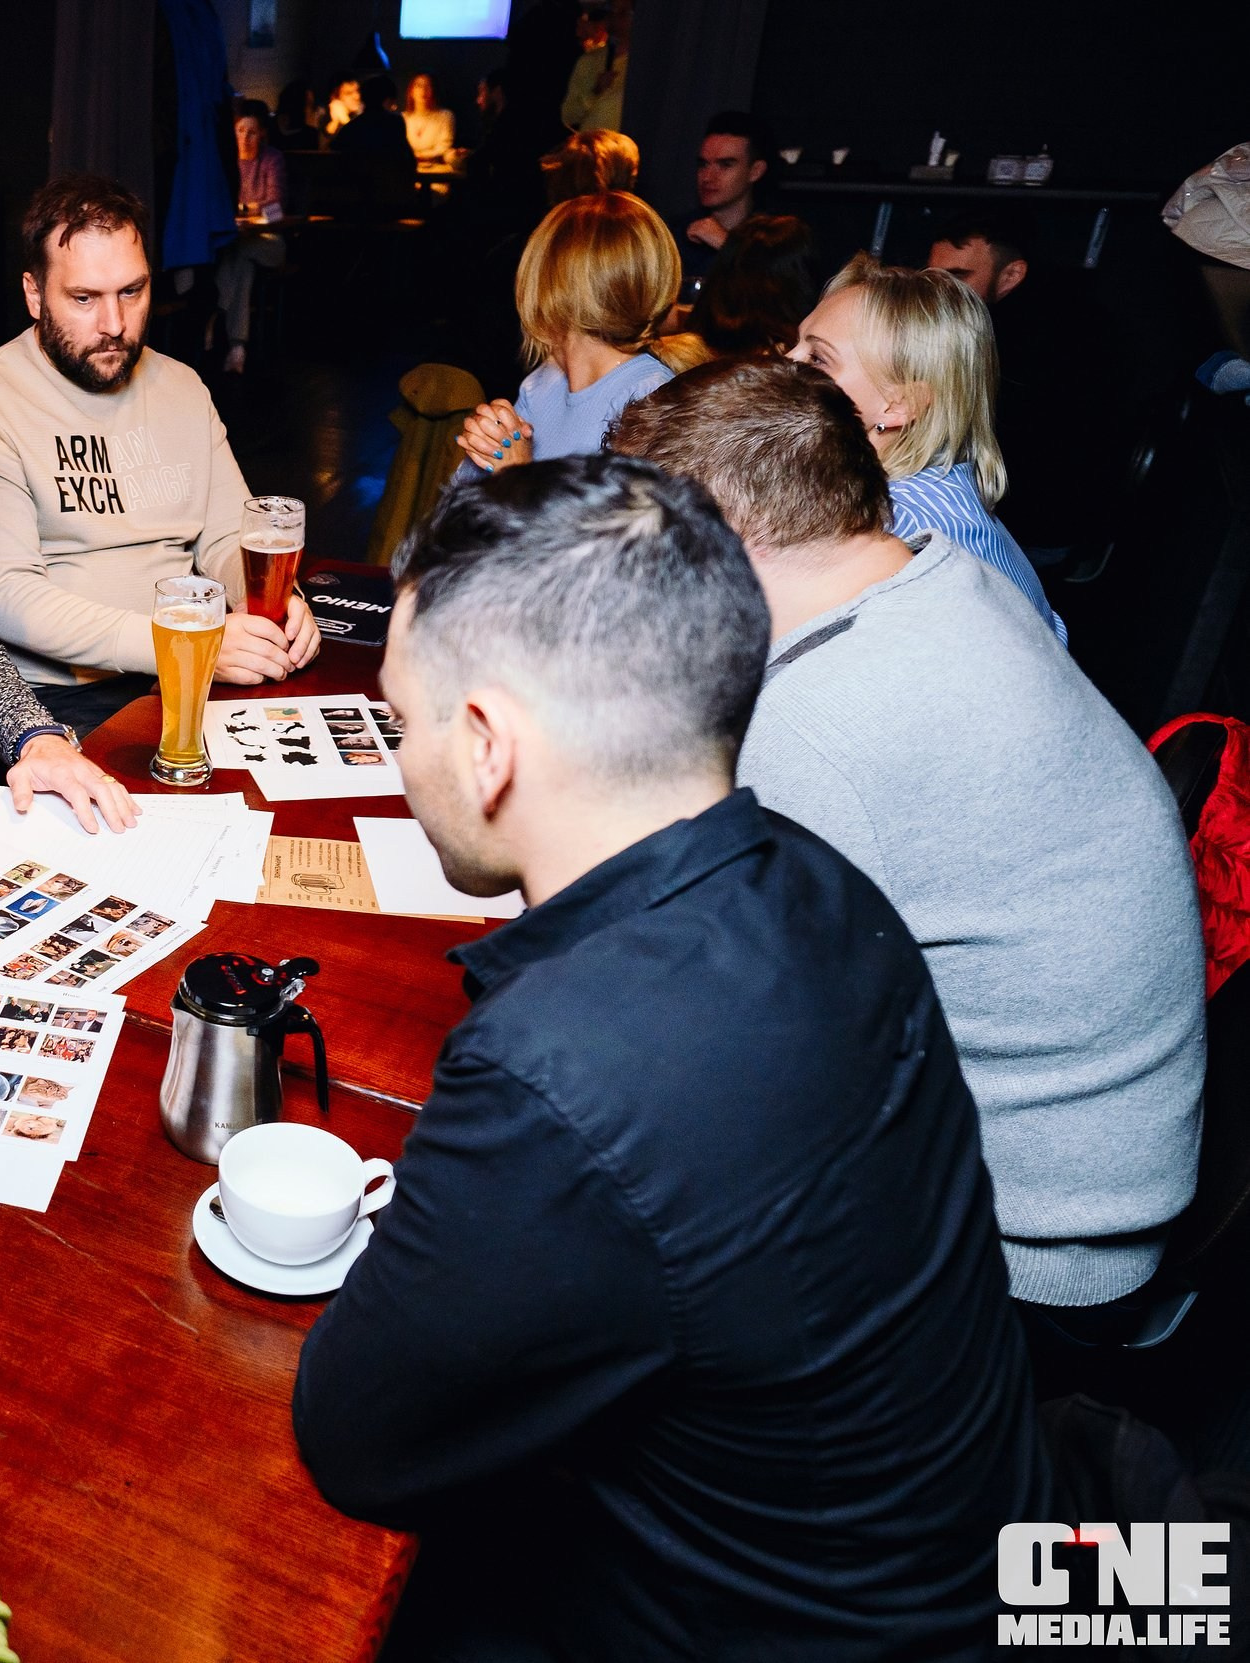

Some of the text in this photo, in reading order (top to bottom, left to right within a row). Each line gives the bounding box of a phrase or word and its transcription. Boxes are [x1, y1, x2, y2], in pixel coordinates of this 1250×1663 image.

[54, 427, 161, 474] ARMANI
[54, 463, 193, 514] EXCHANGE
[311, 595, 392, 614] МЕНЮ
